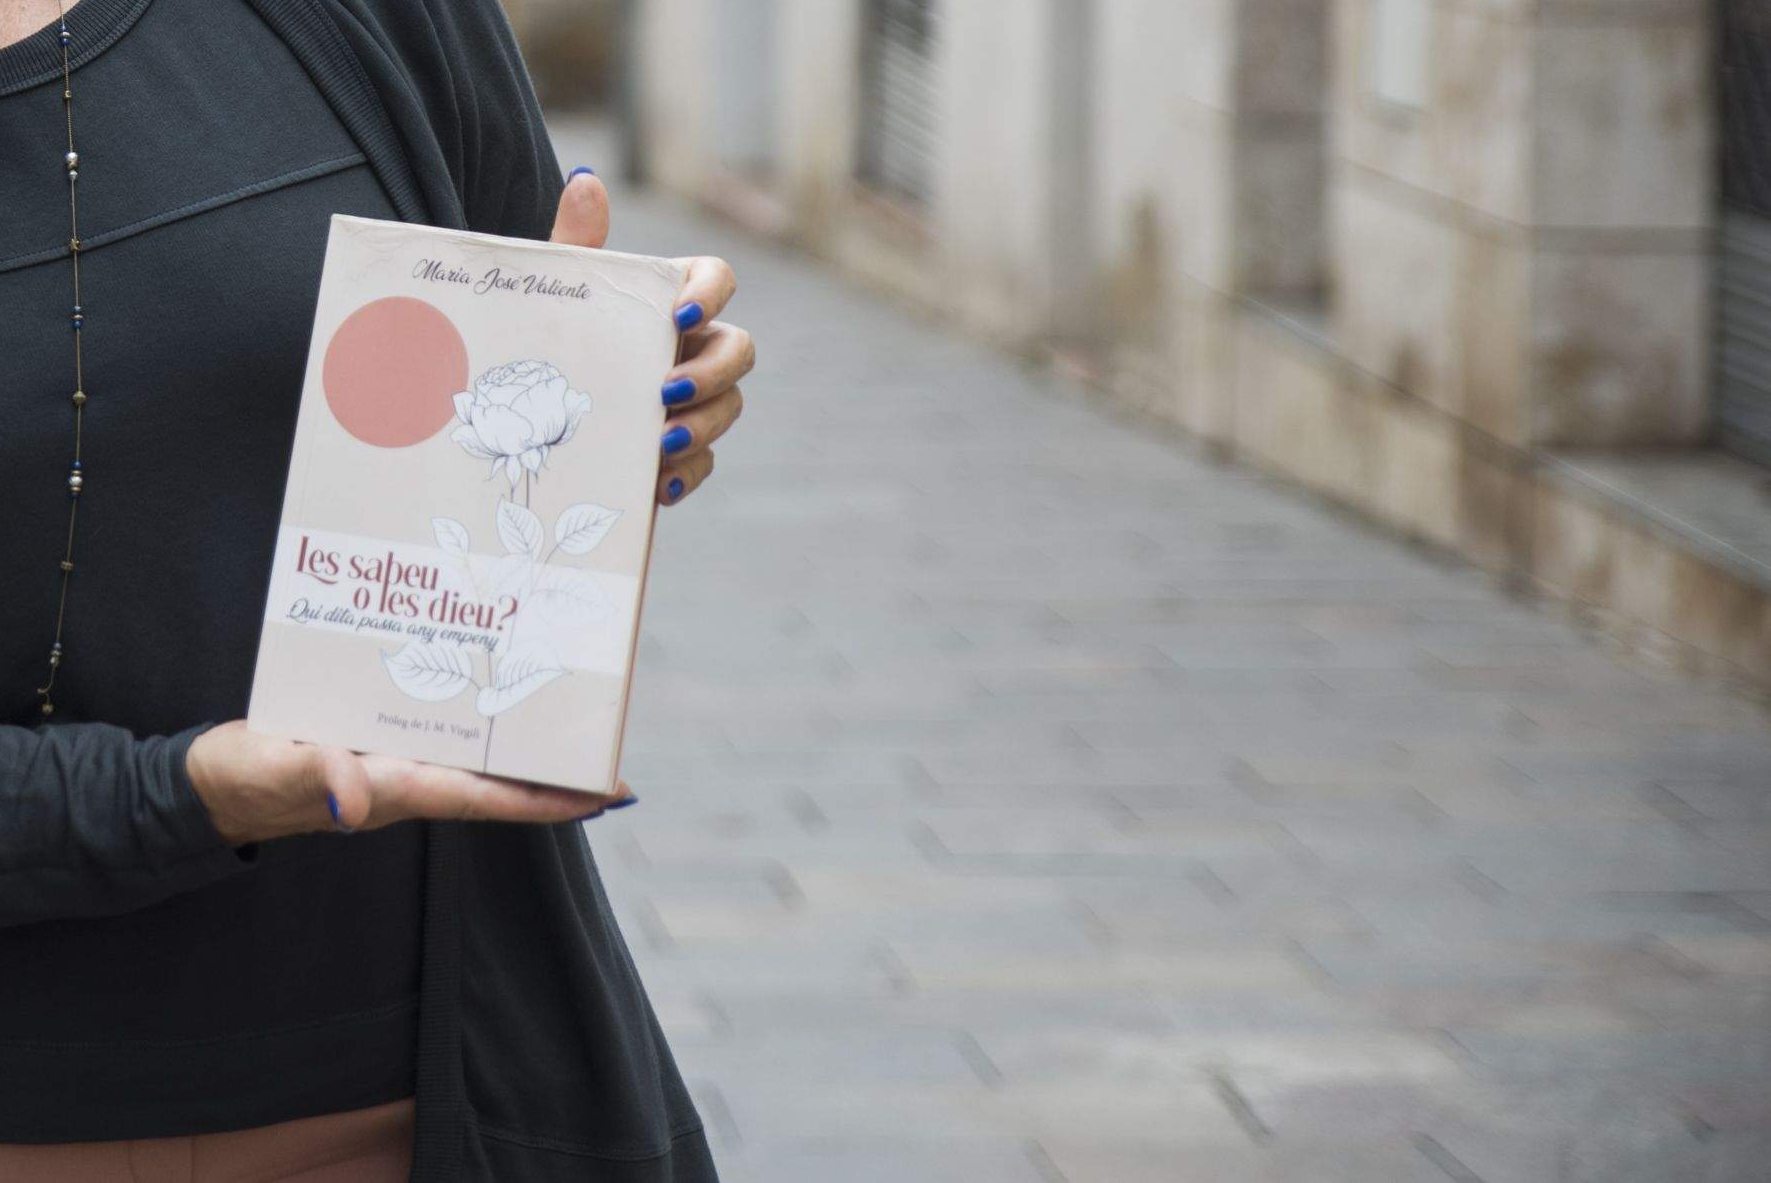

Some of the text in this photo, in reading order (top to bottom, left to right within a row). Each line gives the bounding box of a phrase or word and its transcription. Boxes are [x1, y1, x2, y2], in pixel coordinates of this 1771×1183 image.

[473, 267, 522, 296] José
[523, 274, 592, 300] Valiente
[347, 551, 439, 591] sabeu
[285, 597, 500, 652] Qui dita passa any empeny
[353, 580, 519, 632] o les dieu?
[410, 717, 423, 729] de
[449, 724, 480, 739] Virgili
